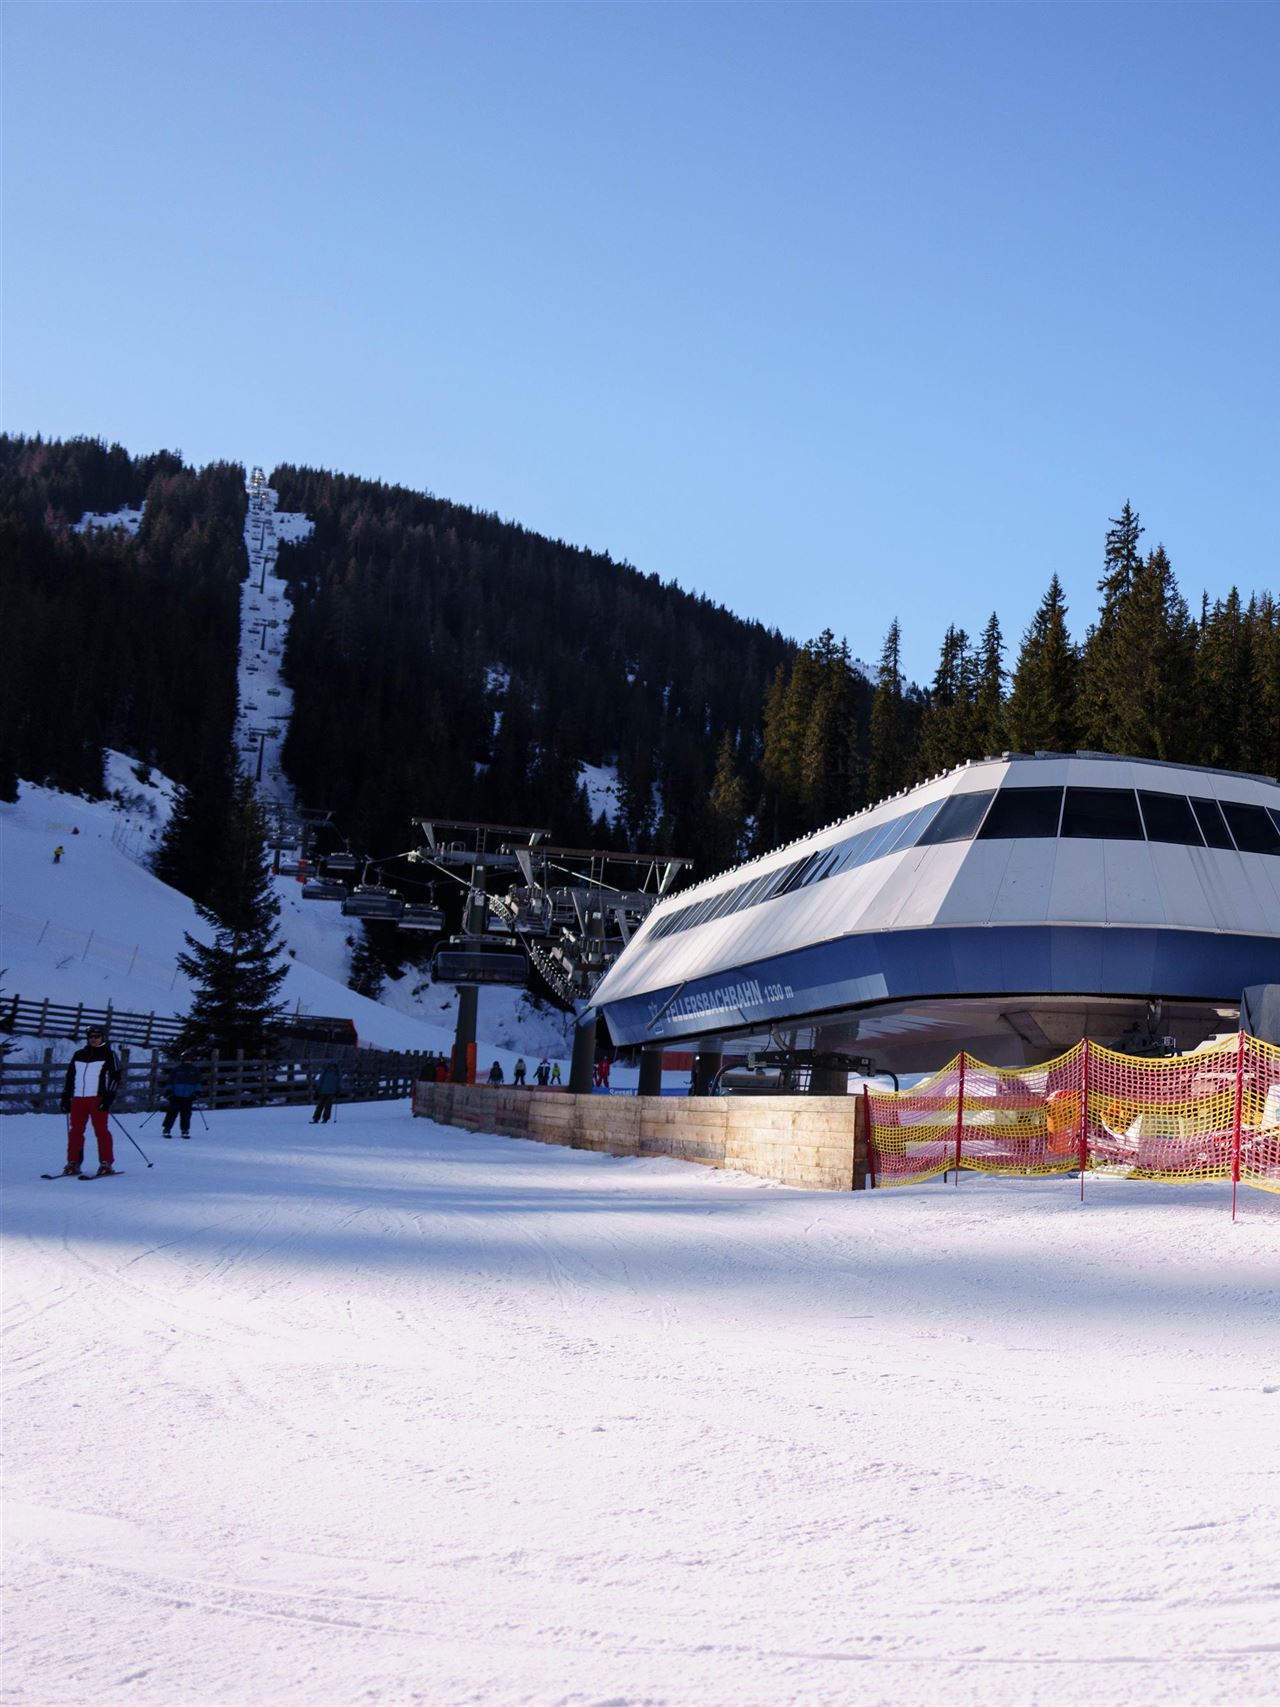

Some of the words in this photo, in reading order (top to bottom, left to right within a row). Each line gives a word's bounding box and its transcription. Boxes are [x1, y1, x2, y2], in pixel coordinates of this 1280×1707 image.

[666, 980, 764, 1023] FELLERSBACHBAHN
[764, 983, 784, 1003] 1330
[784, 985, 794, 999] m
